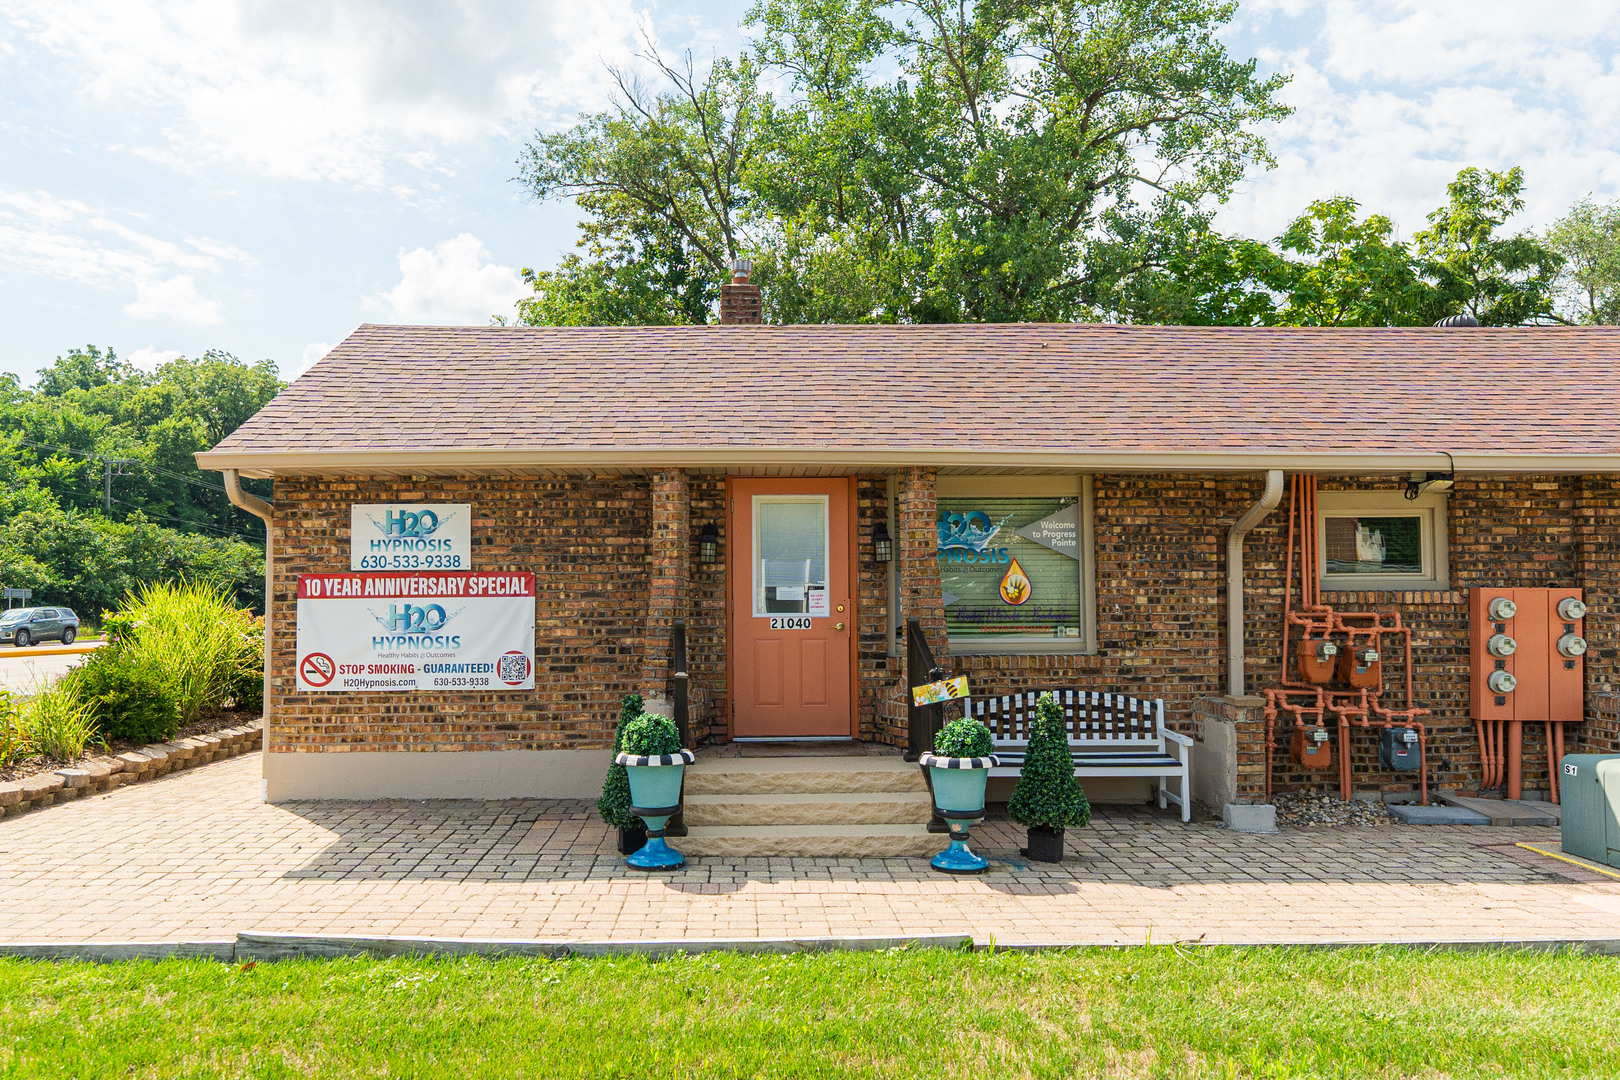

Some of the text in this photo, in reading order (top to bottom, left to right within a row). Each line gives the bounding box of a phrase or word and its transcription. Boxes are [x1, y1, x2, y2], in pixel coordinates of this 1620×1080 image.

[386, 509, 438, 537] H2O
[1040, 521, 1076, 529] Welcome
[1042, 530, 1077, 540] Progress
[370, 539, 452, 552] HYPNOSIS
[1051, 539, 1077, 547] Pointe
[361, 555, 461, 568] 630-533-9338
[937, 547, 1010, 564] PNOSIS
[304, 576, 529, 596] 10 YEAR ANNIVERSARY SPECIAL
[390, 604, 446, 634] H2O
[771, 618, 811, 629] 21040
[372, 636, 460, 650] HYPNOSIS
[339, 664, 365, 674] STOP
[368, 664, 415, 674] SMOKING
[424, 664, 494, 674] GUARANTEED!
[434, 678, 490, 686] 630-533-9338
